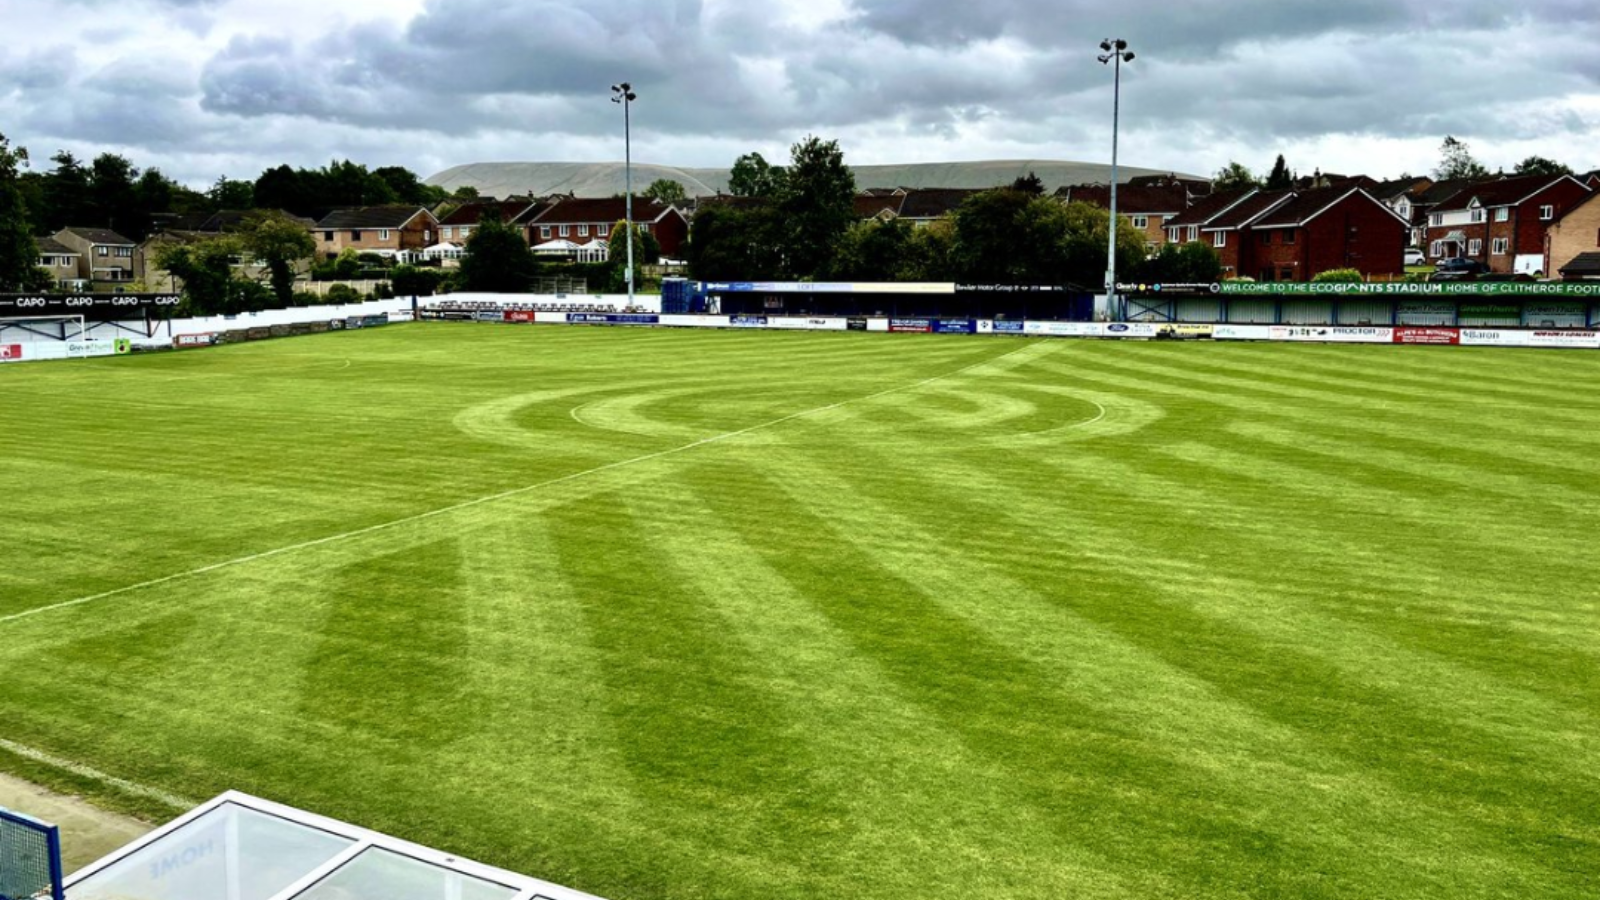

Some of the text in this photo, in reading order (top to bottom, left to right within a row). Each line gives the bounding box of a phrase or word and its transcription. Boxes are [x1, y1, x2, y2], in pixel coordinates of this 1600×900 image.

[995, 284, 1013, 292] Group
[1223, 283, 1270, 292] WELCOME
[1273, 283, 1285, 292] TO
[1288, 283, 1307, 292] THE
[1386, 283, 1442, 292] STADIUM
[1446, 284, 1478, 292] HOME
[1481, 284, 1498, 292] OF
[1500, 284, 1564, 293] CLITHEROE
[1567, 285, 1600, 294] FOOT
[16, 296, 180, 307] CAPO CAPO CAPO CAPO
[1469, 330, 1499, 339] Baron
